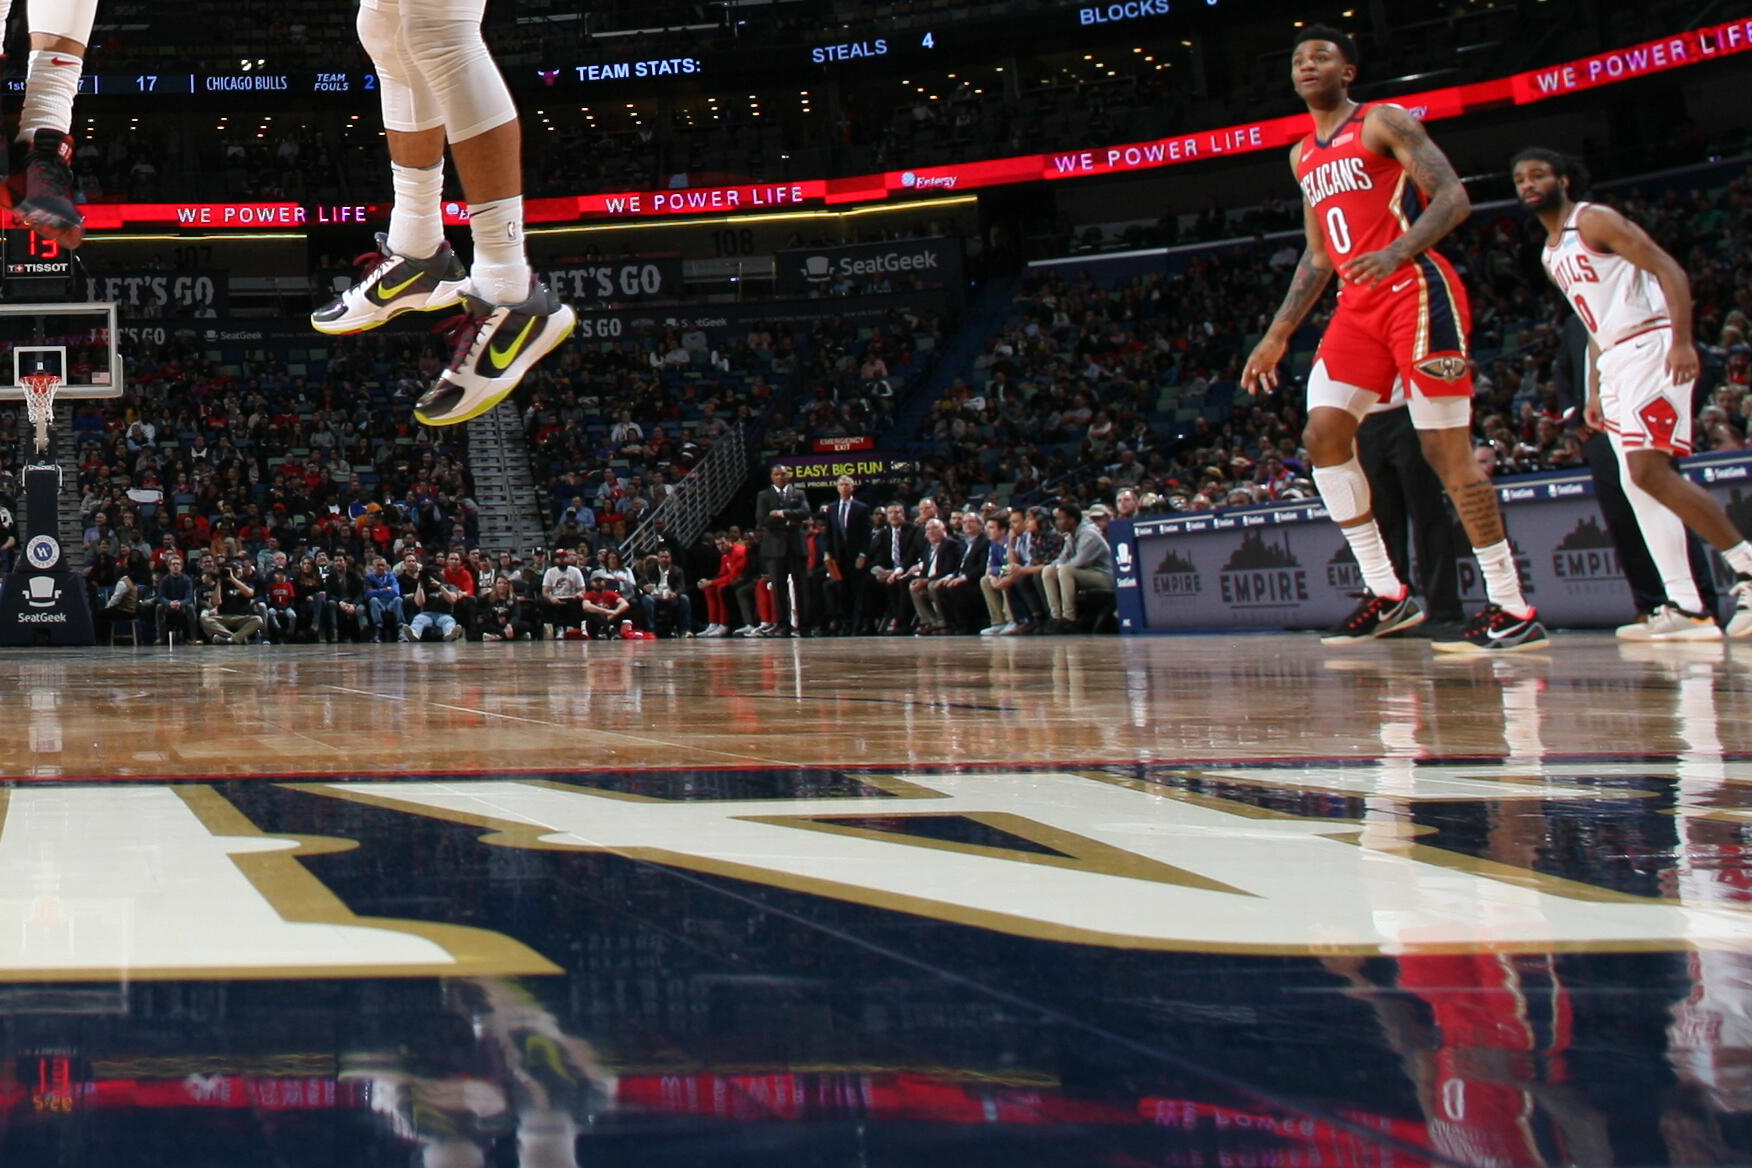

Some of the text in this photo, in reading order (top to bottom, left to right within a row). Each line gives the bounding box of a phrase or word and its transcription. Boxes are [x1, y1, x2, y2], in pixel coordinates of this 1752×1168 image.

[812, 32, 935, 64] STEALS 4
[576, 57, 701, 82] TEAM STATS:
[1537, 67, 1577, 94] WE
[1589, 39, 1687, 81] POWER
[7, 80, 25, 91] 1st
[136, 75, 158, 92] 17
[206, 75, 288, 91] CHICAGO BULLS
[313, 82, 349, 92] FOULS
[316, 73, 346, 82] TEAM
[364, 75, 375, 90] 2
[1054, 153, 1094, 173] WE
[1107, 139, 1198, 168] POWER
[1211, 126, 1263, 153] LIFE
[1300, 157, 1373, 208] ELICANS
[605, 186, 804, 213] WE POWER LIFE
[177, 206, 367, 223] WE POWER LIFE
[1326, 206, 1352, 254] 0
[24, 263, 68, 273] TISSOT
[840, 250, 937, 276] SeatGeek
[86, 276, 215, 307] LET'S GO
[548, 264, 662, 298] ET'S GO
[1574, 293, 1598, 334] 0
[142, 328, 166, 345] GO
[597, 318, 622, 338] GO
[796, 464, 829, 478] EASY.
[832, 462, 855, 476] BIG
[858, 460, 886, 475] FUN.
[1153, 573, 1202, 594] EMPIRE
[1220, 570, 1309, 604] EMPIRE
[18, 612, 67, 623] SeatGeek
